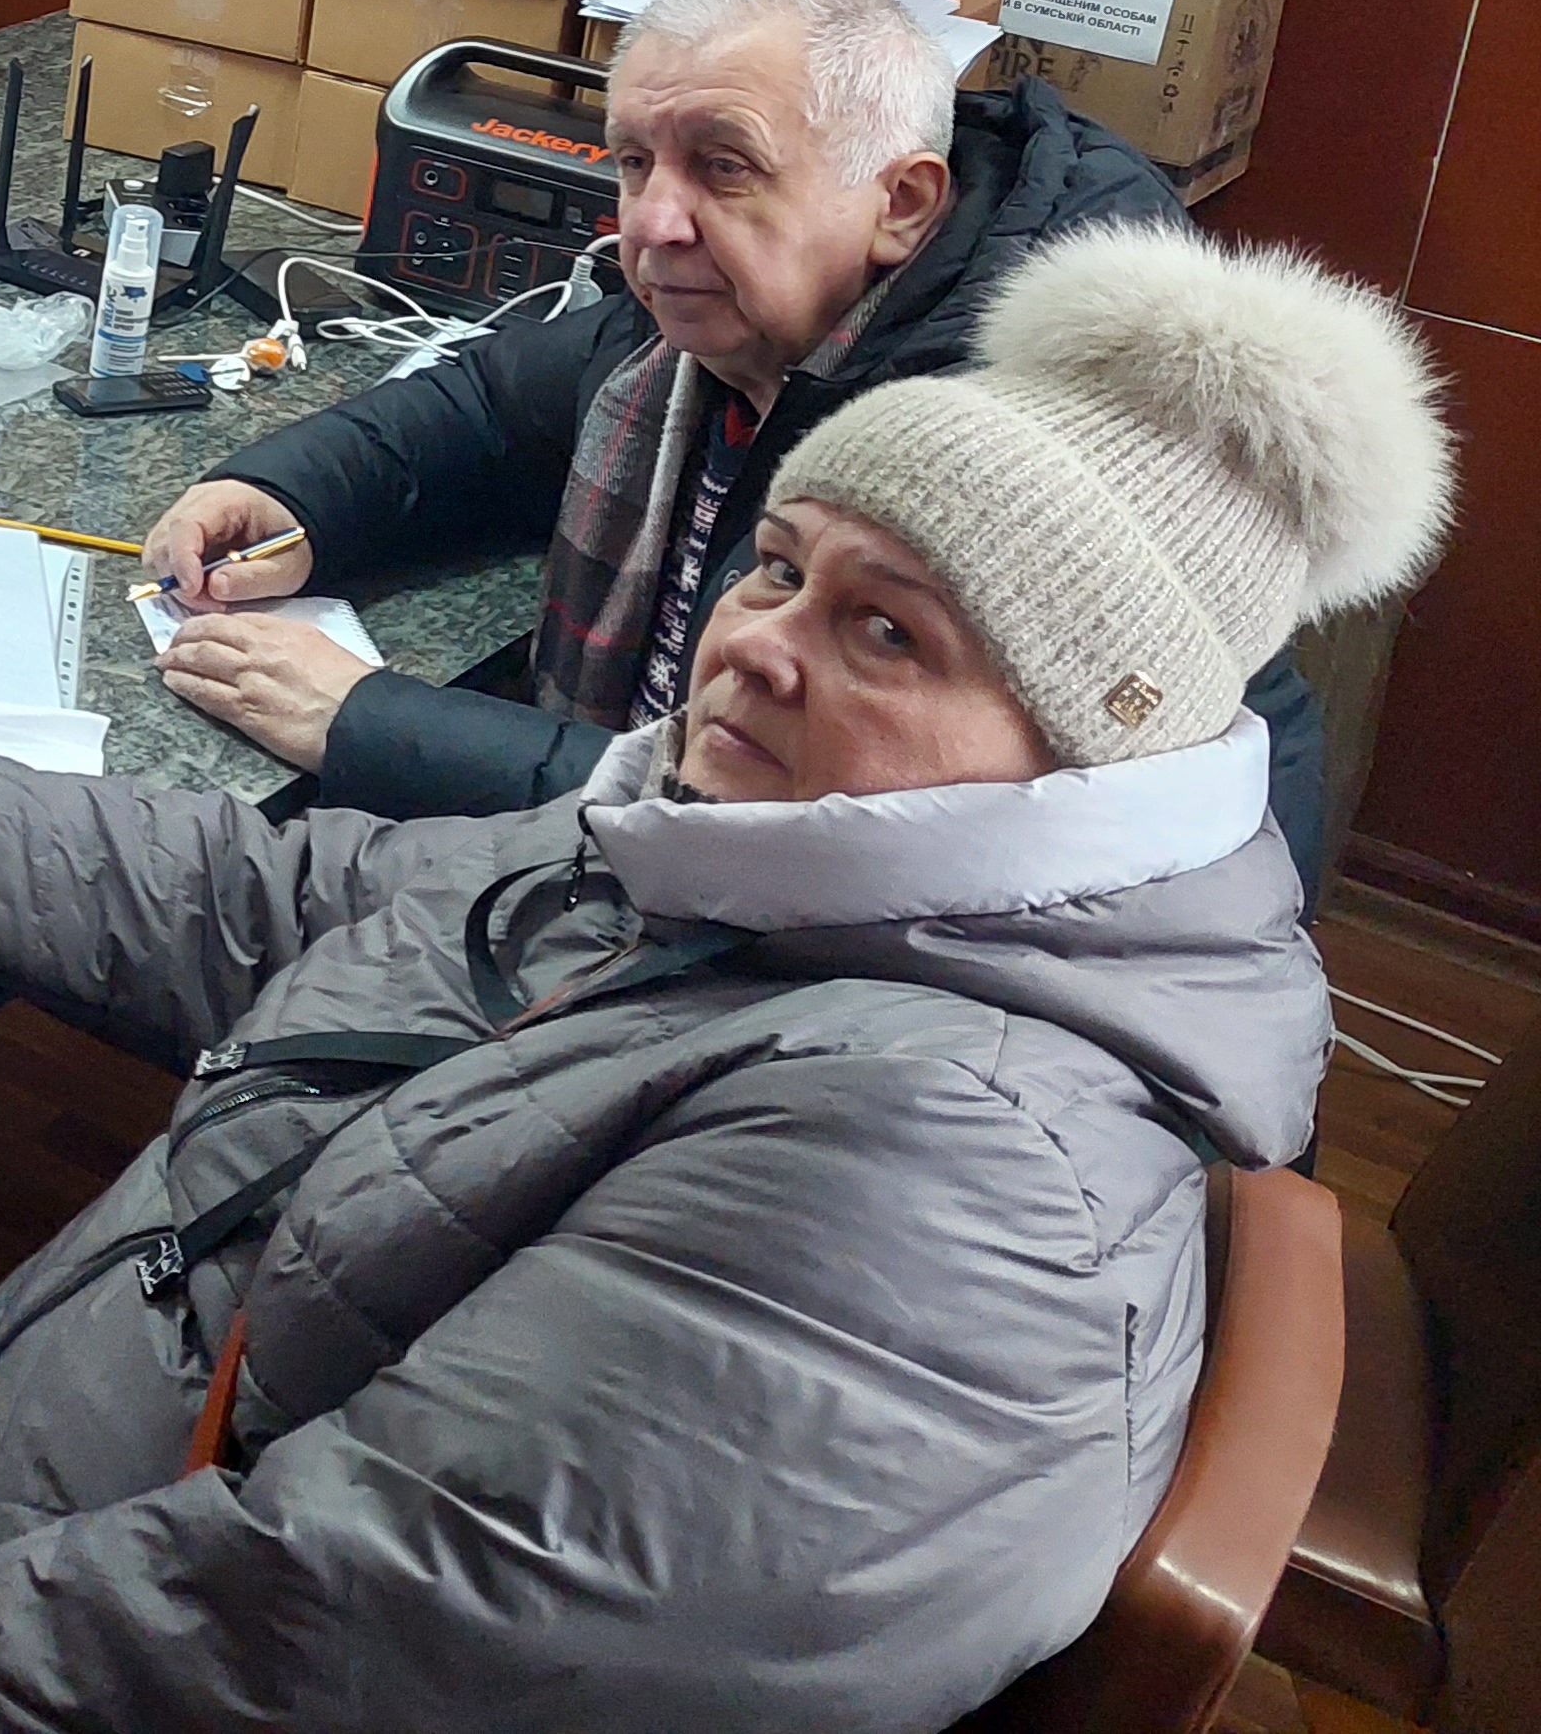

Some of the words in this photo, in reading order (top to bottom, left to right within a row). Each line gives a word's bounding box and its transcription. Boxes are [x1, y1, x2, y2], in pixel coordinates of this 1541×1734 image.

[1013, 0, 1022, 11] В
[1024, 3, 1086, 25] СУМСЬКІЙ
[1088, 18, 1141, 37] ОБЛАСТІ
[1103, 5, 1157, 25] ОСОБАМ
[471, 118, 611, 164] Jackery
